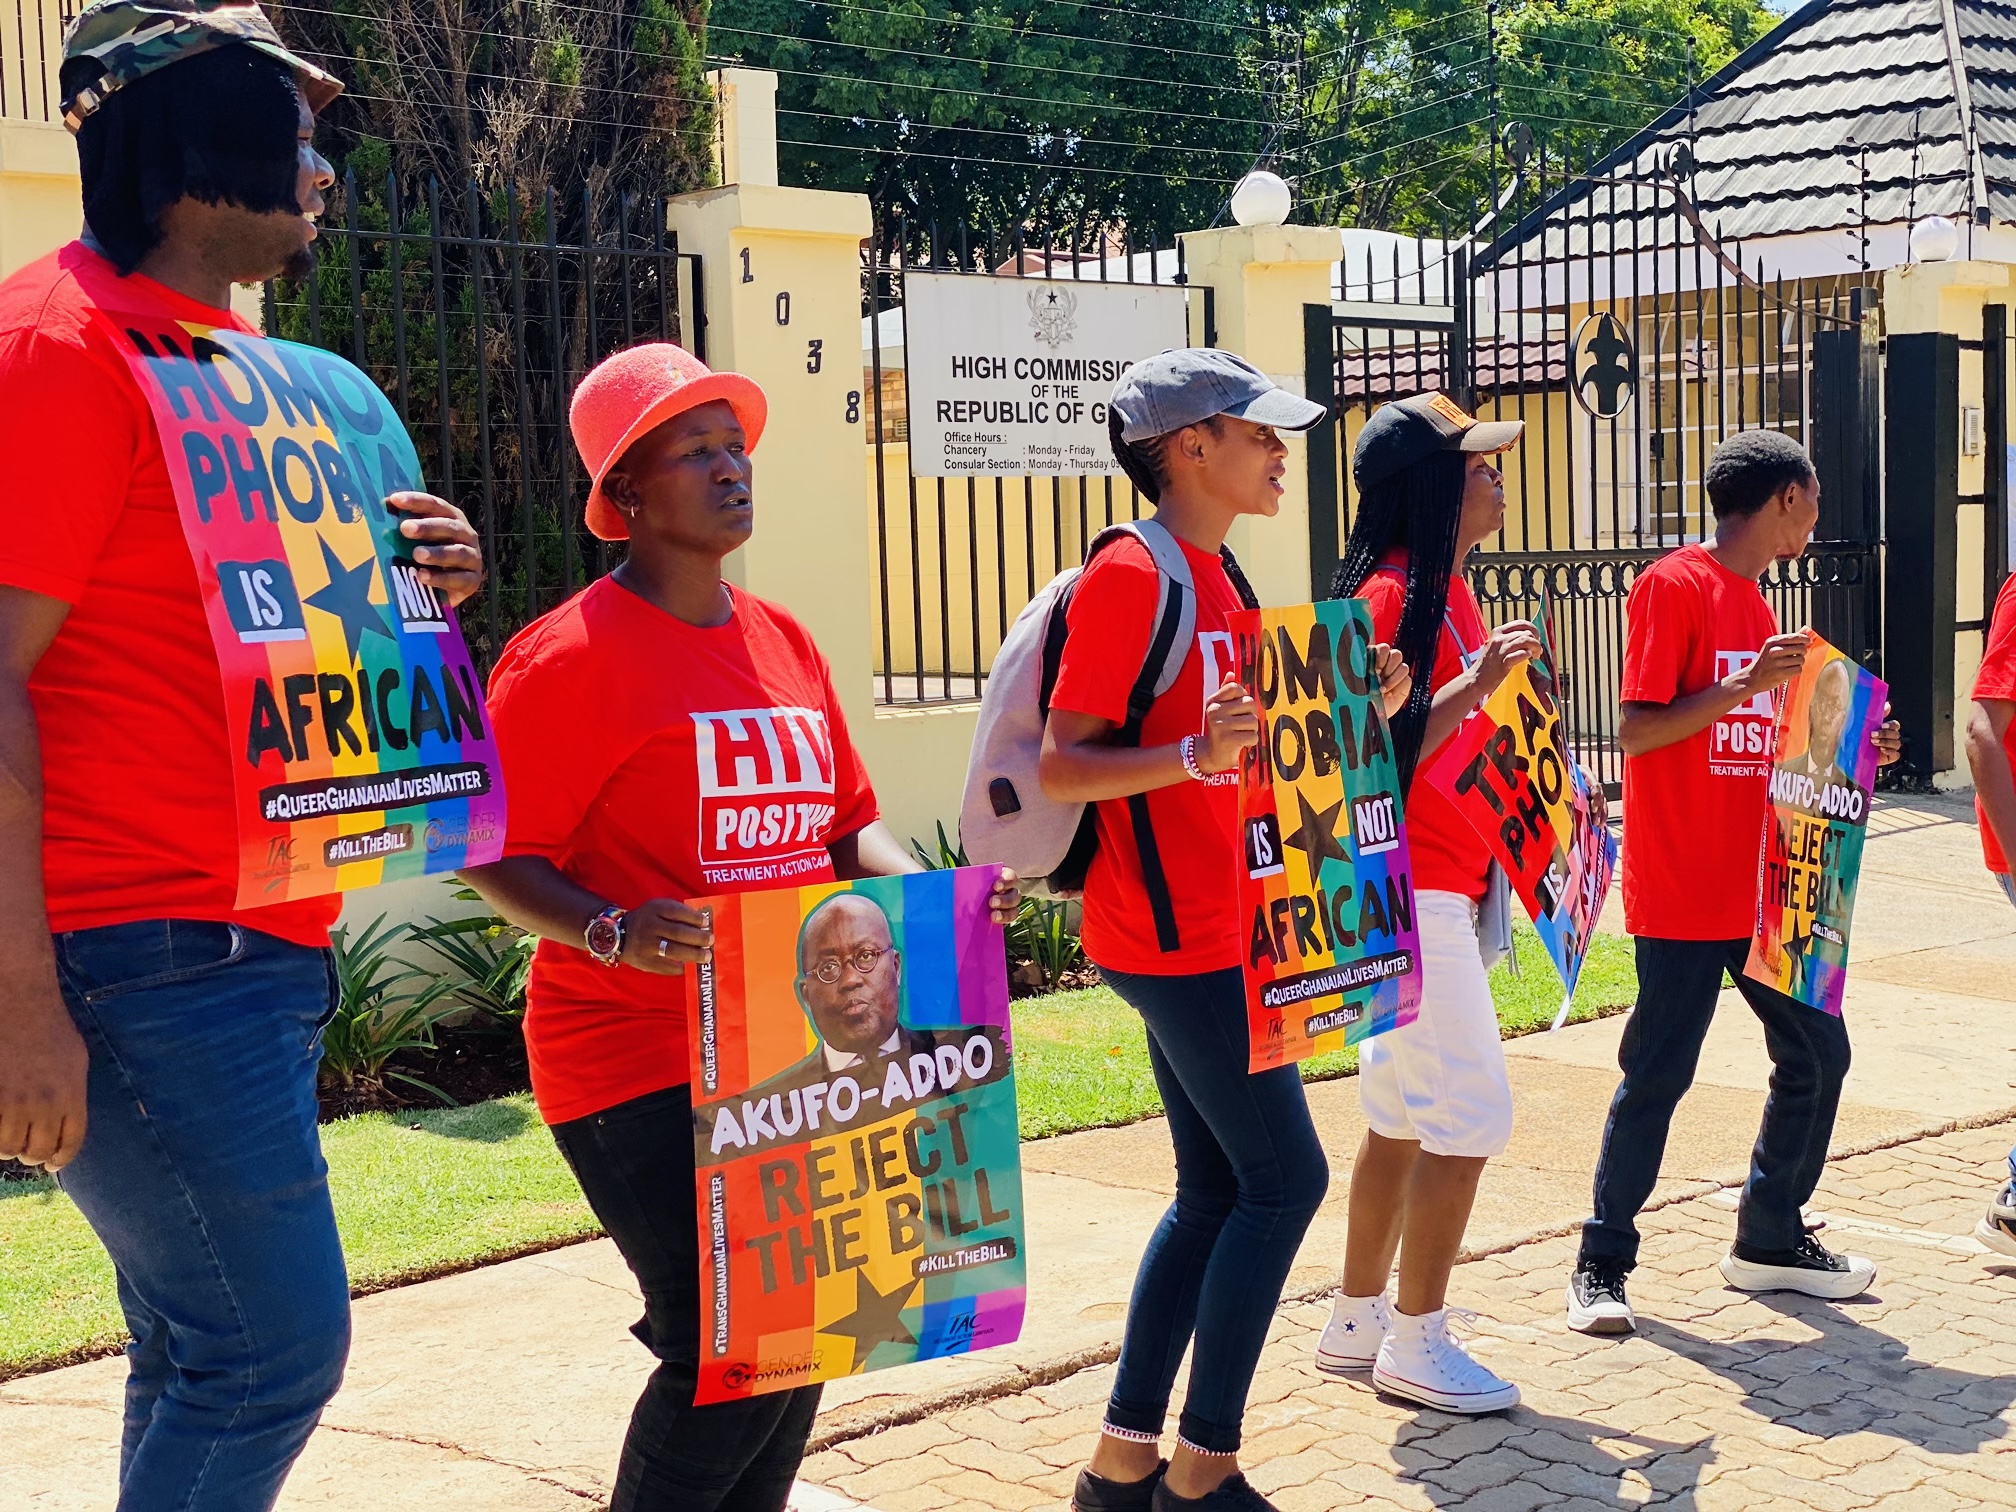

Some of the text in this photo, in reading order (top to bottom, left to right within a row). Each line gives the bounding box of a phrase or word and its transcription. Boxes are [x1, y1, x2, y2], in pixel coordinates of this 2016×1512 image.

[739, 247, 754, 284] 1
[807, 339, 823, 374] 3
[845, 390, 860, 424] 8
[125, 327, 384, 436] HOMO
[951, 355, 1007, 379] HIGH
[936, 400, 1049, 424] REPUBLIC
[1056, 401, 1085, 424] OF
[1031, 384, 1079, 399] OF THE
[943, 445, 987, 456] Chancery
[1028, 445, 1062, 456] Monday
[1069, 445, 1095, 457] Friday
[944, 431, 972, 443] Office
[974, 432, 1002, 443] Hours
[944, 459, 986, 470] Consular
[987, 459, 1021, 470] Section
[1028, 459, 1062, 471] Monday
[1069, 459, 1109, 471] Thursday
[239, 569, 282, 627] IS
[1239, 617, 1376, 711] HOMO
[246, 664, 486, 768] AFRICAN
[1709, 765, 1755, 777] TREATMENT
[1768, 767, 1863, 821] AKUFO-ADDO
[1355, 797, 1396, 844] NOT
[266, 835, 299, 867] TAC
[1252, 821, 1273, 866] IS
[1775, 815, 1846, 871] REJECT
[702, 864, 783, 884] TREATMENT
[780, 857, 813, 878] ACTION
[1542, 861, 1567, 905] IS
[1768, 862, 1847, 920] THE BILL
[1248, 871, 1412, 972] AFRICAN
[1266, 1018, 1287, 1041] TAC
[710, 1034, 994, 1155] AKUFO-ADDO
[757, 1102, 971, 1224] REJECT
[745, 1167, 1010, 1295] THE BILL
[949, 1311, 984, 1335] TAC
[753, 1361, 822, 1383] DYNAMIX
[756, 1350, 824, 1373] GENDER
